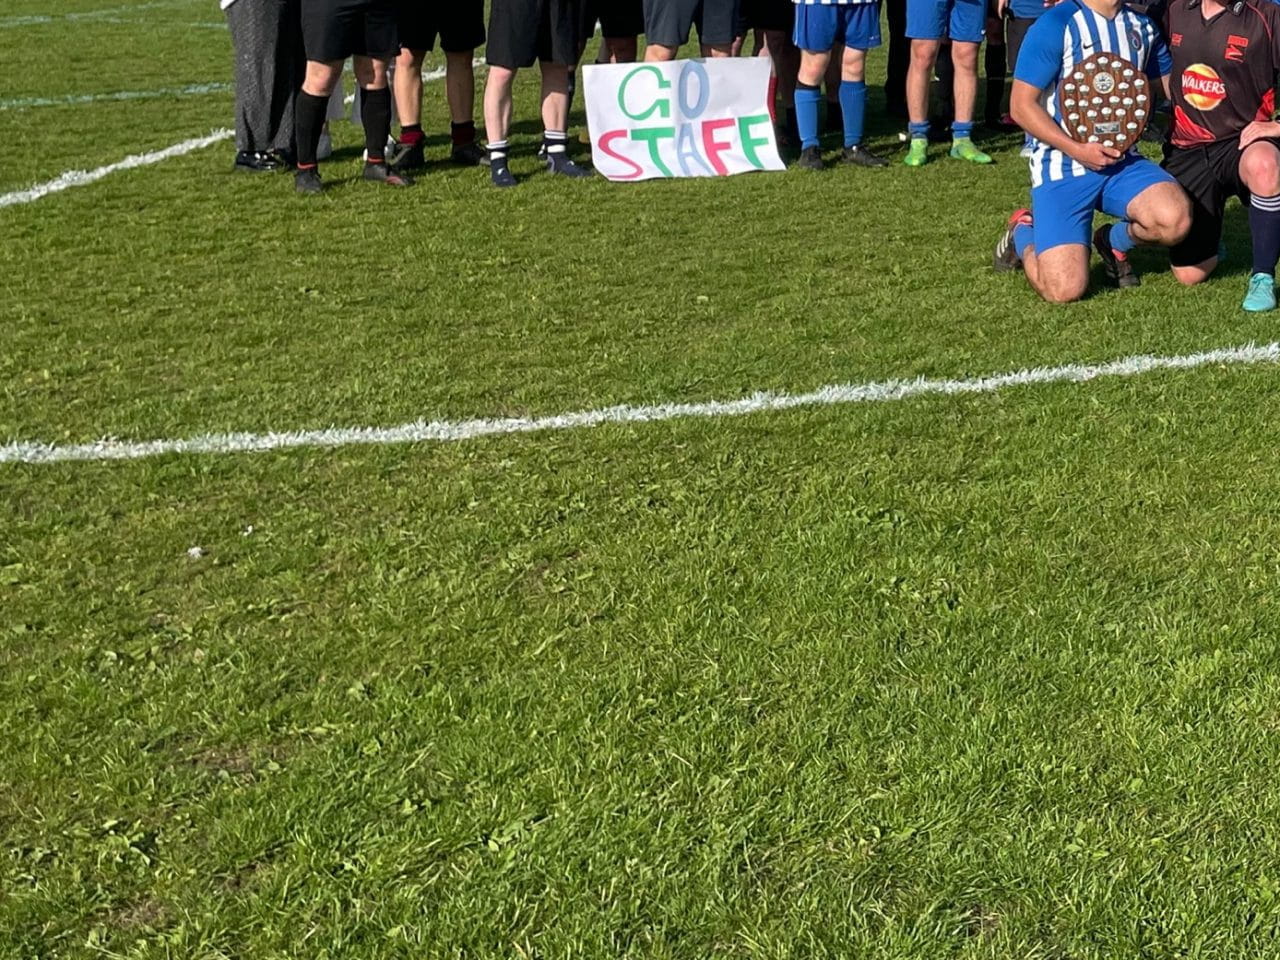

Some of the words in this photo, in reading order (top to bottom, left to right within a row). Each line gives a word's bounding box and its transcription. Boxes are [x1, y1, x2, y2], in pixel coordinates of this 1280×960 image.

[618, 59, 710, 121] GO
[1181, 74, 1226, 95] WALKERS
[598, 113, 770, 179] STAFF
